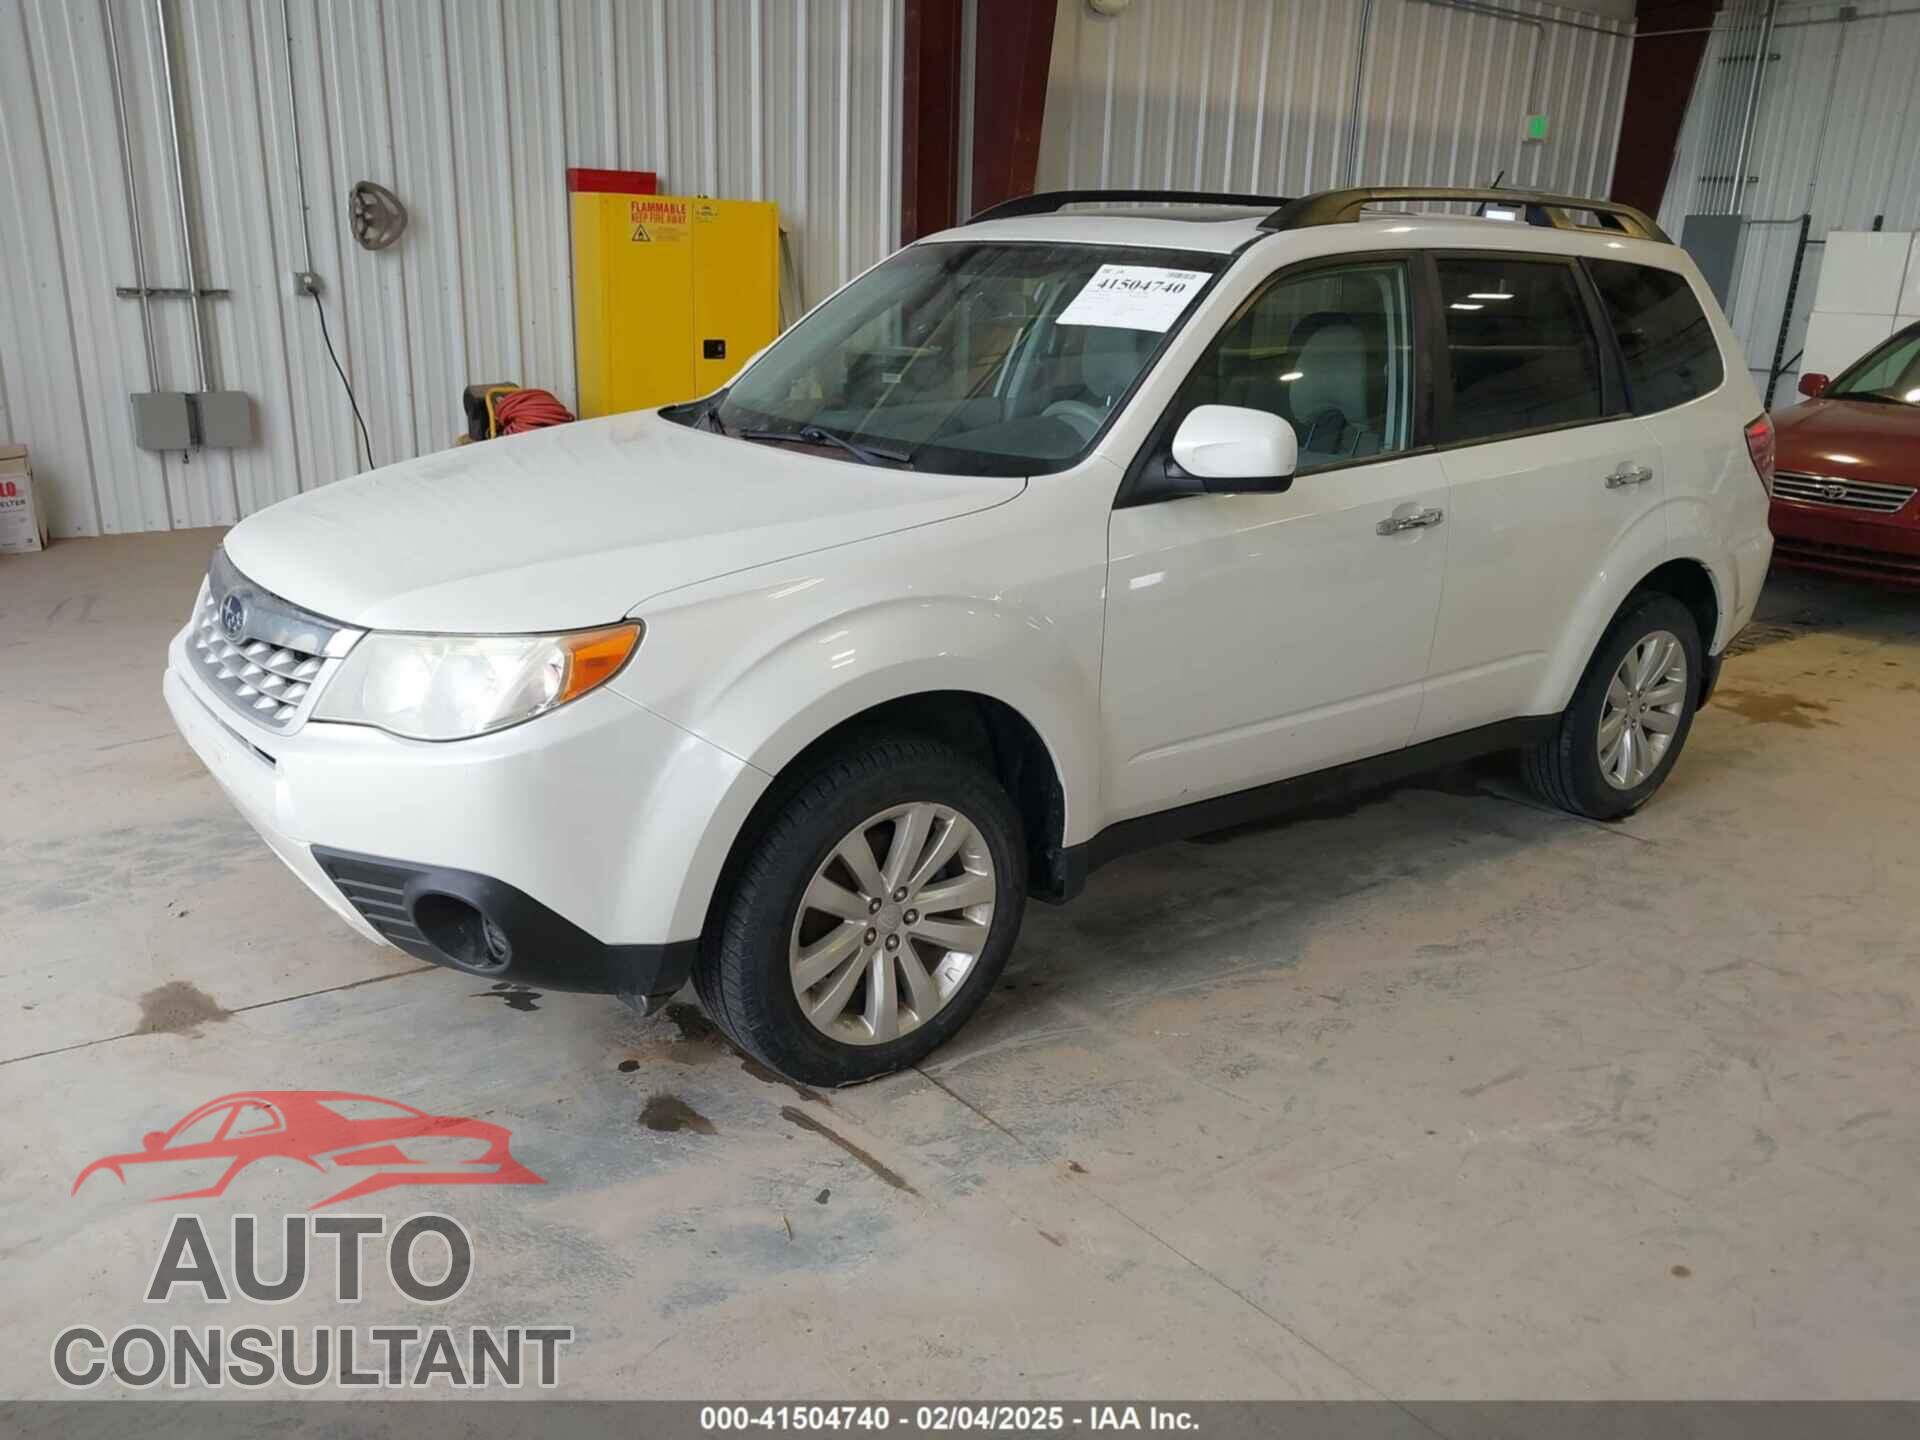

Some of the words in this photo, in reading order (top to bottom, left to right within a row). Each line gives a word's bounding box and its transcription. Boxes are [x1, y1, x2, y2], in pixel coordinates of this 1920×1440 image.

[631, 201, 686, 214] FLAMMABLE
[631, 213, 648, 224] KEEP
[649, 213, 664, 224] FIRE
[666, 214, 686, 225] AWAY
[1097, 279, 1186, 293] 41504740
